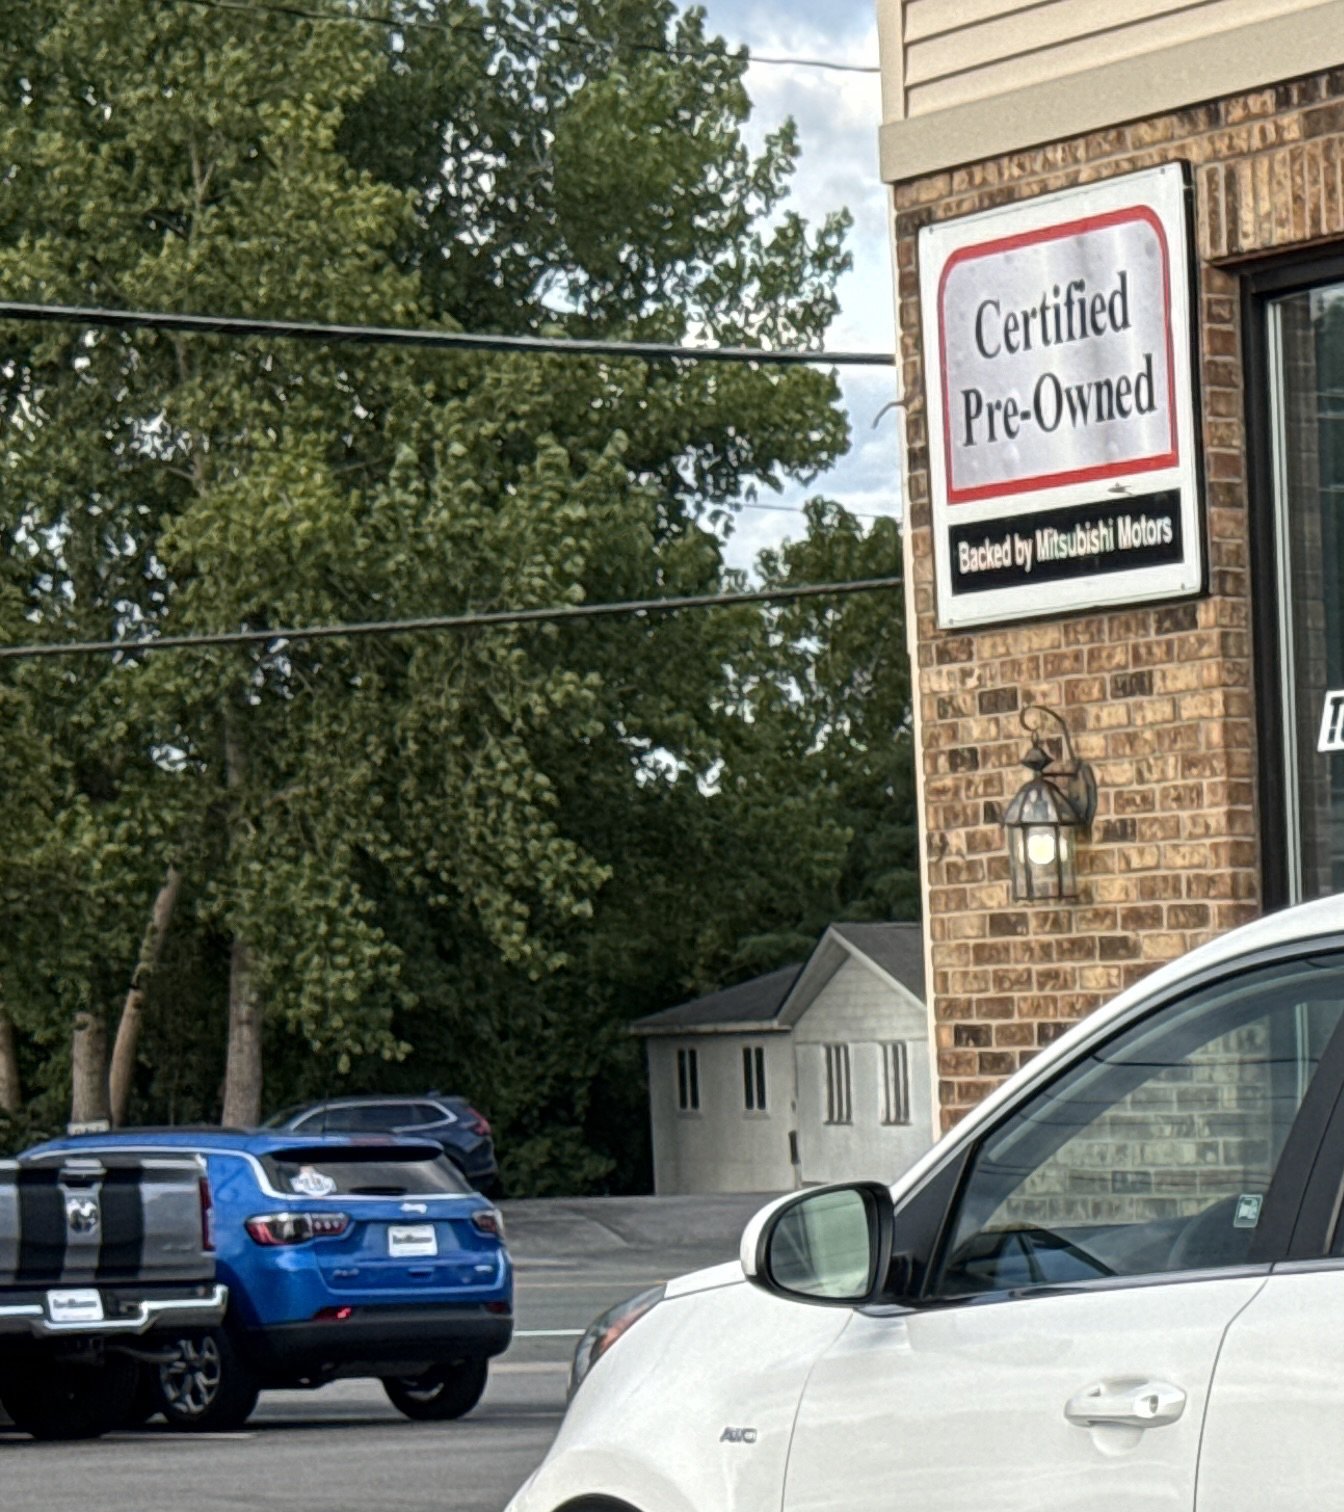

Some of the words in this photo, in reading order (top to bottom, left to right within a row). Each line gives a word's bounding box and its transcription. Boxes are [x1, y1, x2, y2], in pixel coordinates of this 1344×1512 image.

[975, 271, 1131, 360] Certified
[962, 353, 1157, 447] Pre-Owned
[958, 534, 1012, 574] Backed
[1014, 533, 1033, 573] by
[1035, 518, 1115, 562] Mitsubishi
[1116, 513, 1173, 550] Motors
